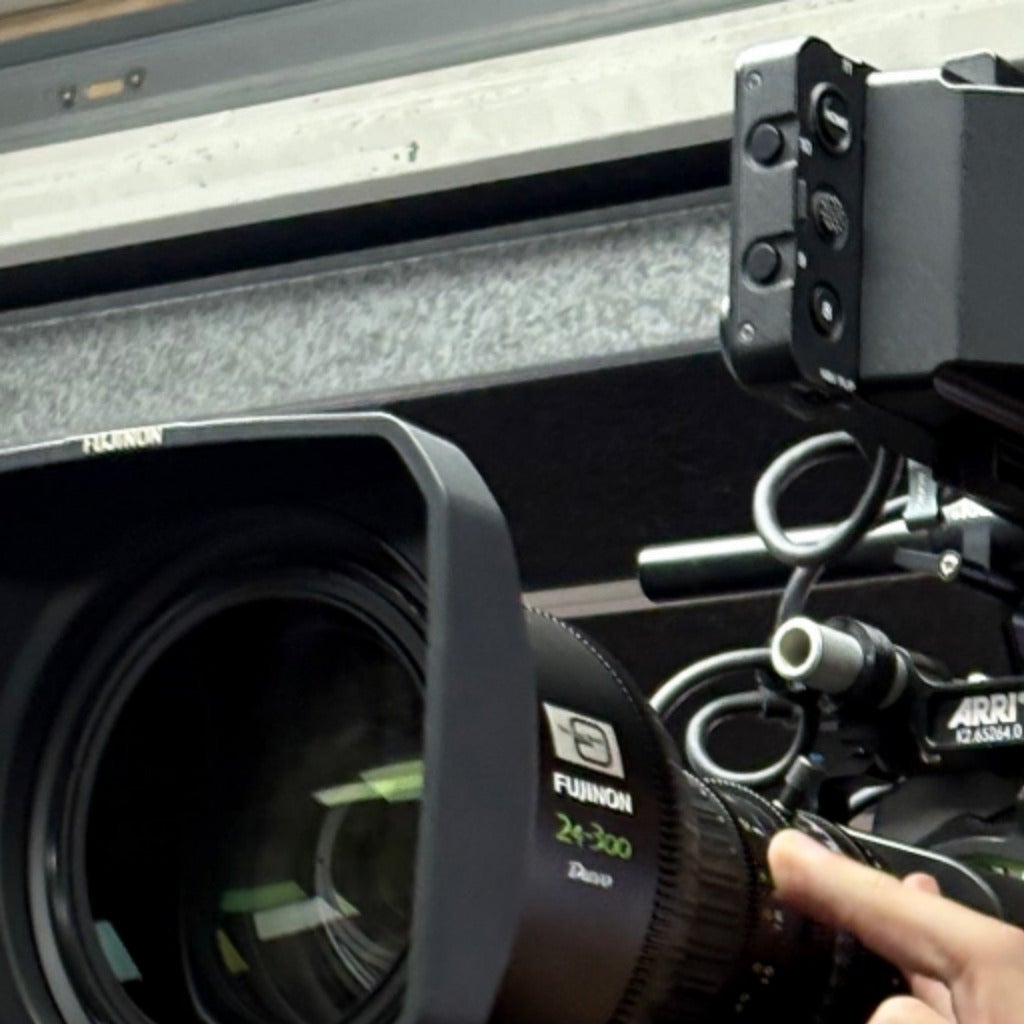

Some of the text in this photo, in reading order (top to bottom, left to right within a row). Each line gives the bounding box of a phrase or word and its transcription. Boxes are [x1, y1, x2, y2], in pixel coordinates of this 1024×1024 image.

[947, 692, 1017, 730] ARRI
[552, 772, 634, 816] FUJINON
[555, 812, 633, 860] 24-300
